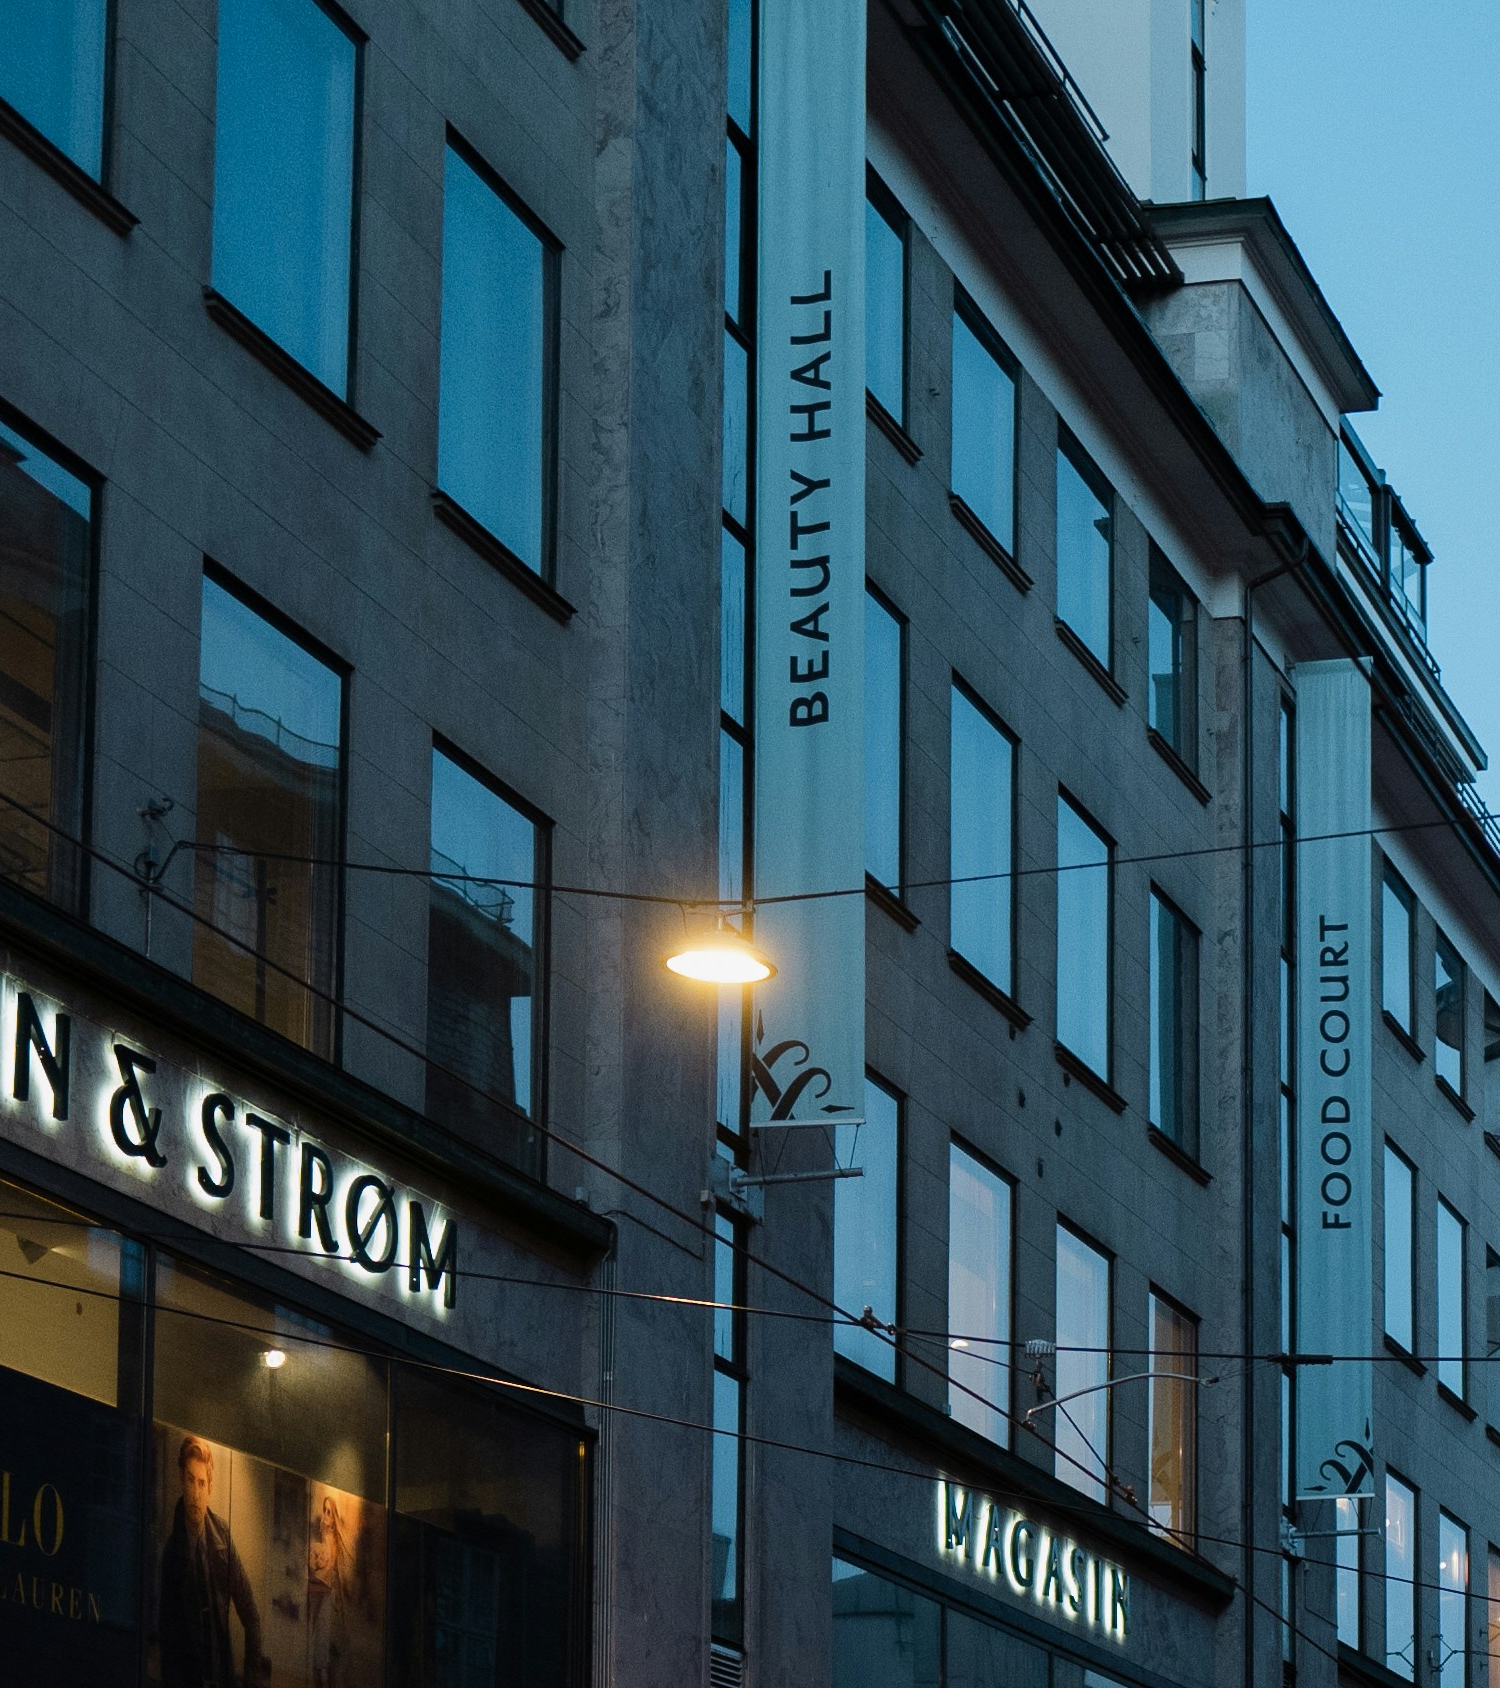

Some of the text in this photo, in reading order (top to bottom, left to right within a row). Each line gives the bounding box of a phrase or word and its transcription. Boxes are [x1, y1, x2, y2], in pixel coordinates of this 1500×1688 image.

[790, 269, 832, 728] BEAUTY HALL
[108, 1043, 168, 1167] &
[197, 1092, 457, 1310] STRØM
[1319, 915, 1352, 1229] FOOD COURT
[944, 1480, 1130, 1635] MAGASIN
